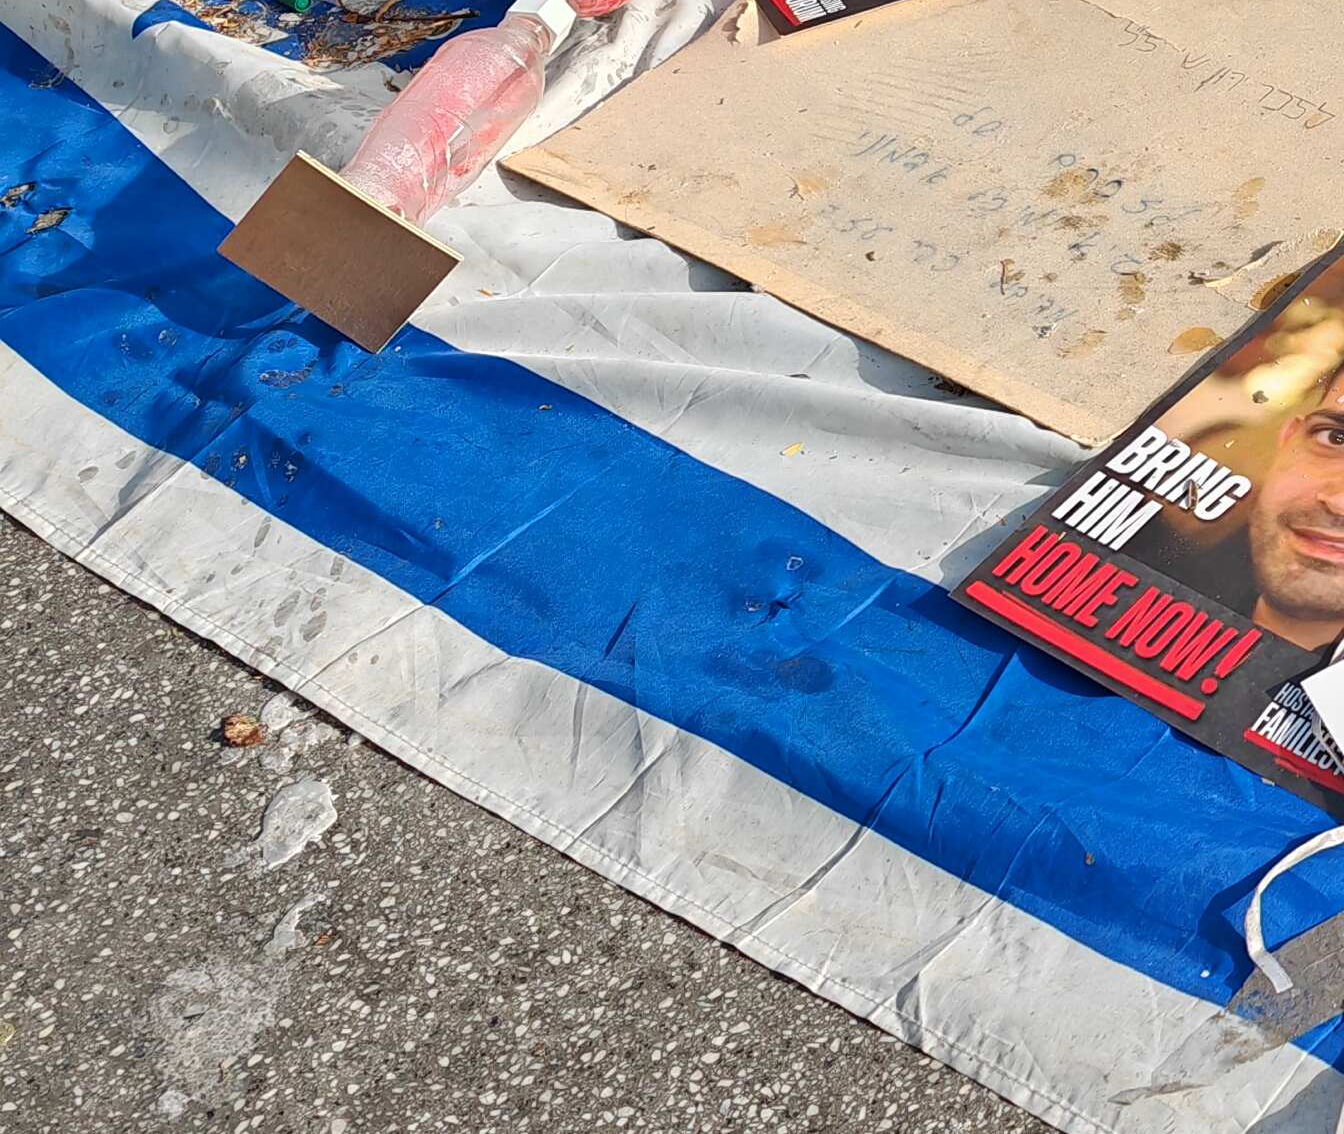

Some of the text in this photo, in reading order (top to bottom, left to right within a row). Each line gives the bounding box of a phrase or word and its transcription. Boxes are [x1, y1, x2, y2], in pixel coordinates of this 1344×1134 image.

[1051, 470, 1164, 552] HIM
[1105, 425, 1253, 523] BRING
[991, 524, 1263, 694] HOME NOW!
